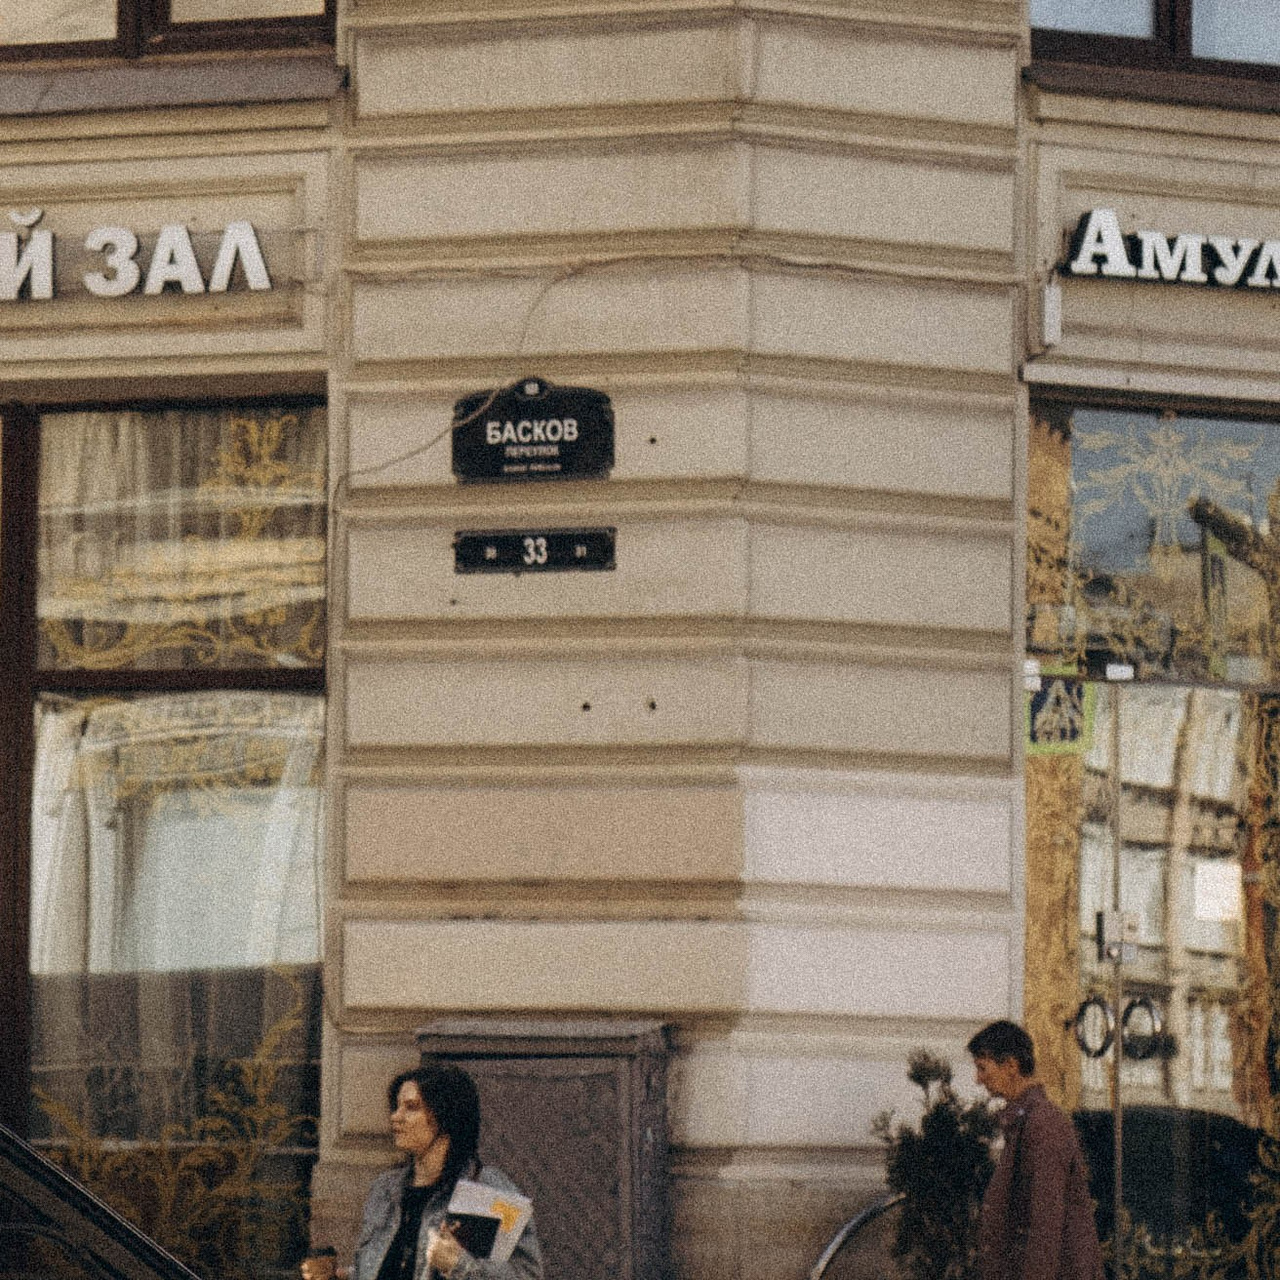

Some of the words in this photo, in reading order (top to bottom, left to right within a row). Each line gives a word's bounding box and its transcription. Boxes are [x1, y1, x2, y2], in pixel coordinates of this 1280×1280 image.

[83, 221, 272, 297] ЗАЛ
[486, 418, 579, 445] БАСКОВ
[523, 537, 548, 564] 33
